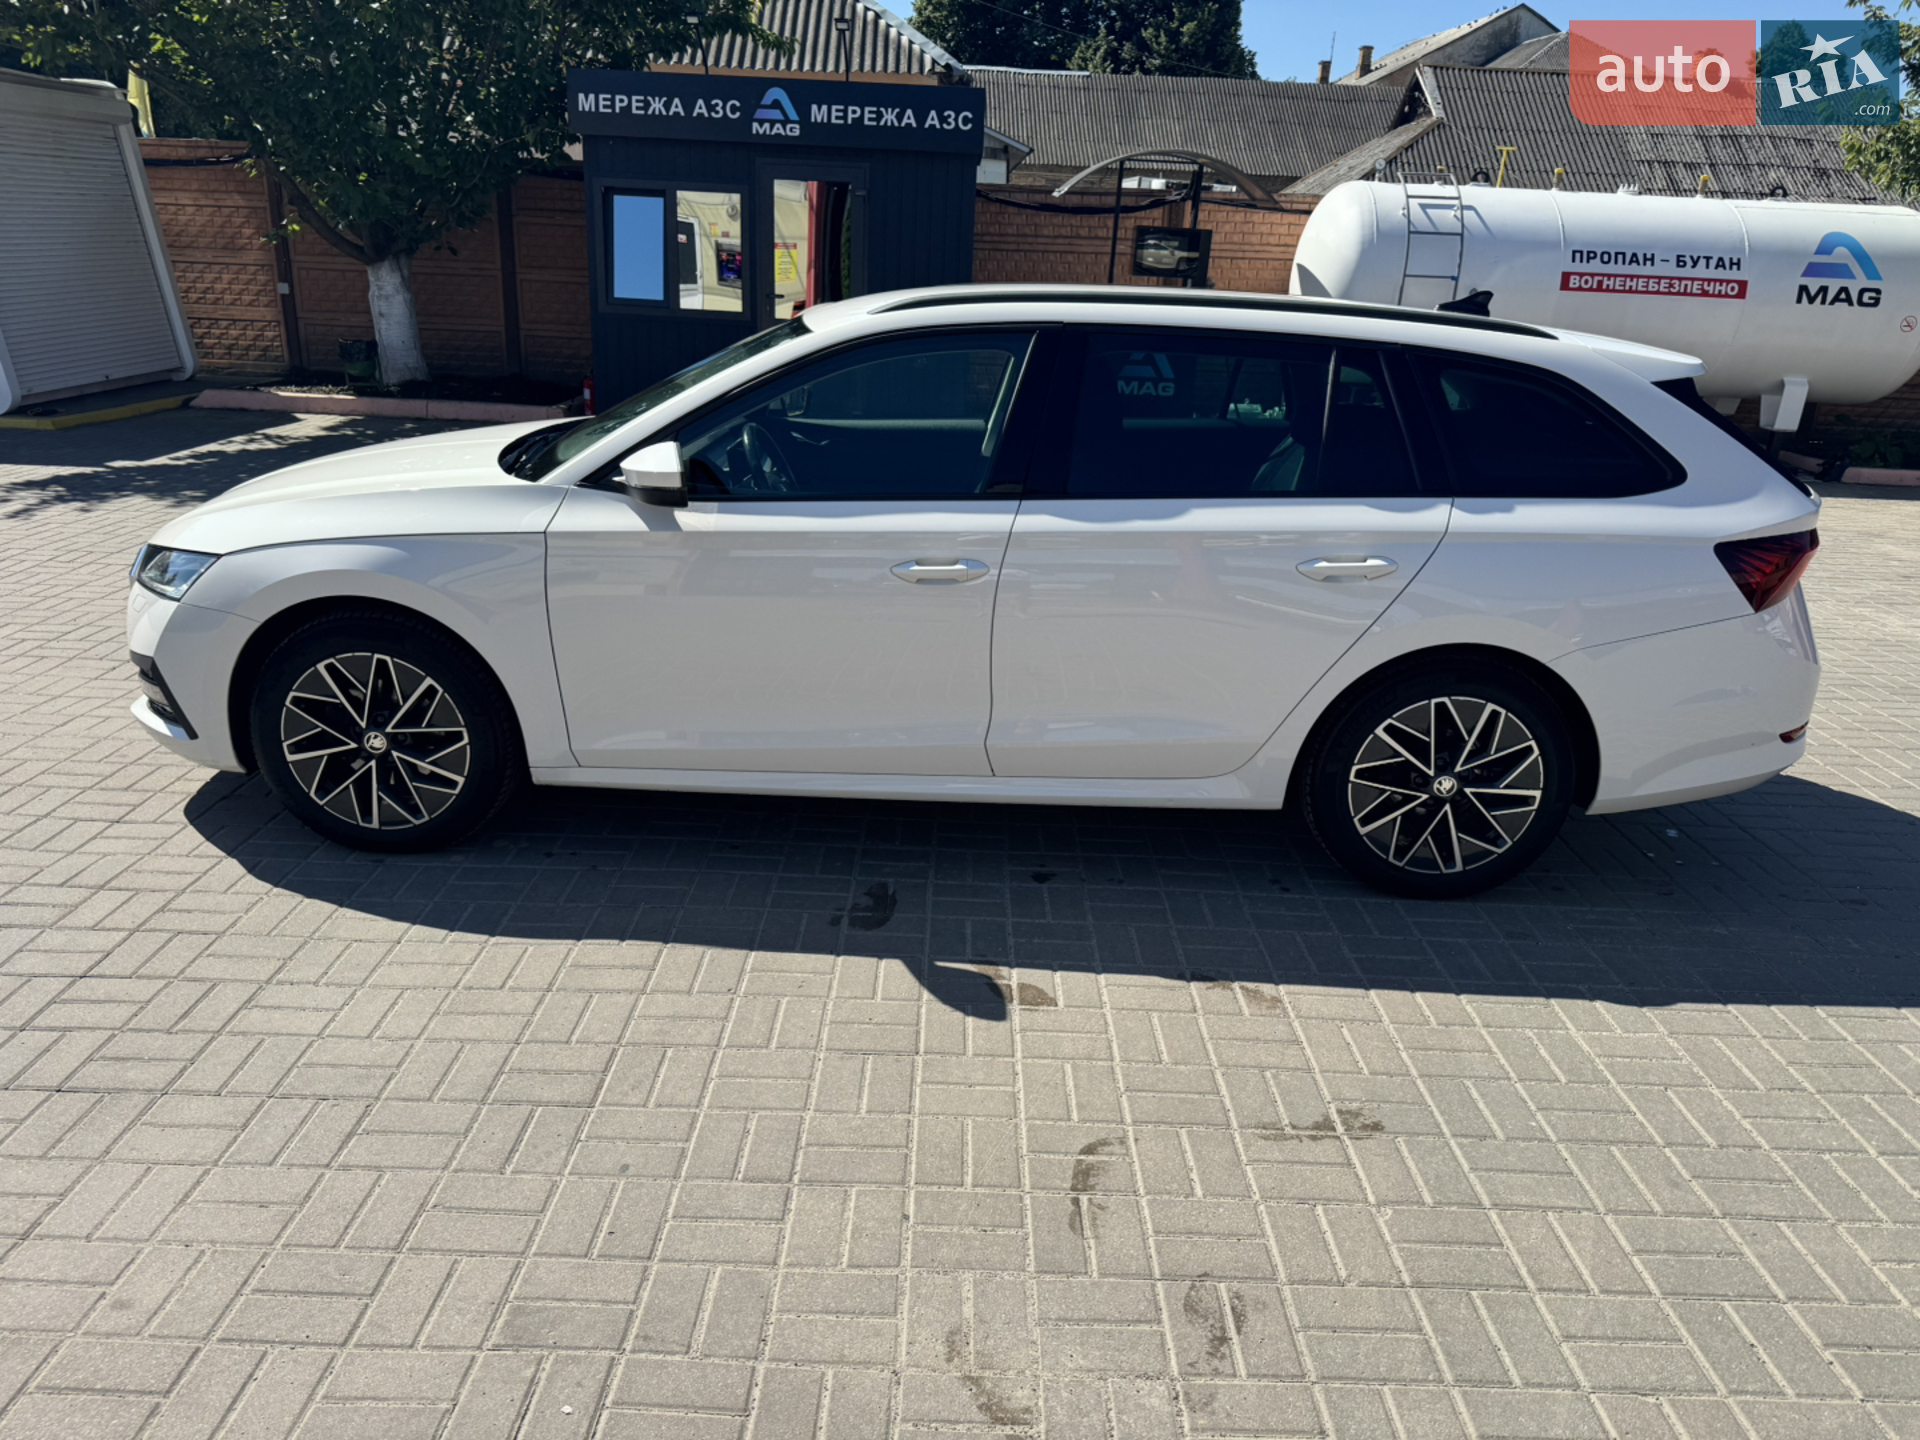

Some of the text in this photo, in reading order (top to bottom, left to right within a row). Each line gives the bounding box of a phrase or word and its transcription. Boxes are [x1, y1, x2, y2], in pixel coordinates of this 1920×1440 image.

[578, 93, 741, 120] МЕРЕЖА АЗС
[811, 104, 973, 131] МЕРЕЖА АЗС
[752, 122, 801, 136] MAG
[1571, 250, 1656, 267] ПРОПАН
[1676, 254, 1742, 272] БУТАН
[1568, 275, 1739, 296] ВОГНЕНЕБЕЗПЕЧНО
[1795, 284, 1882, 308] MAG
[1117, 380, 1175, 396] MAG
